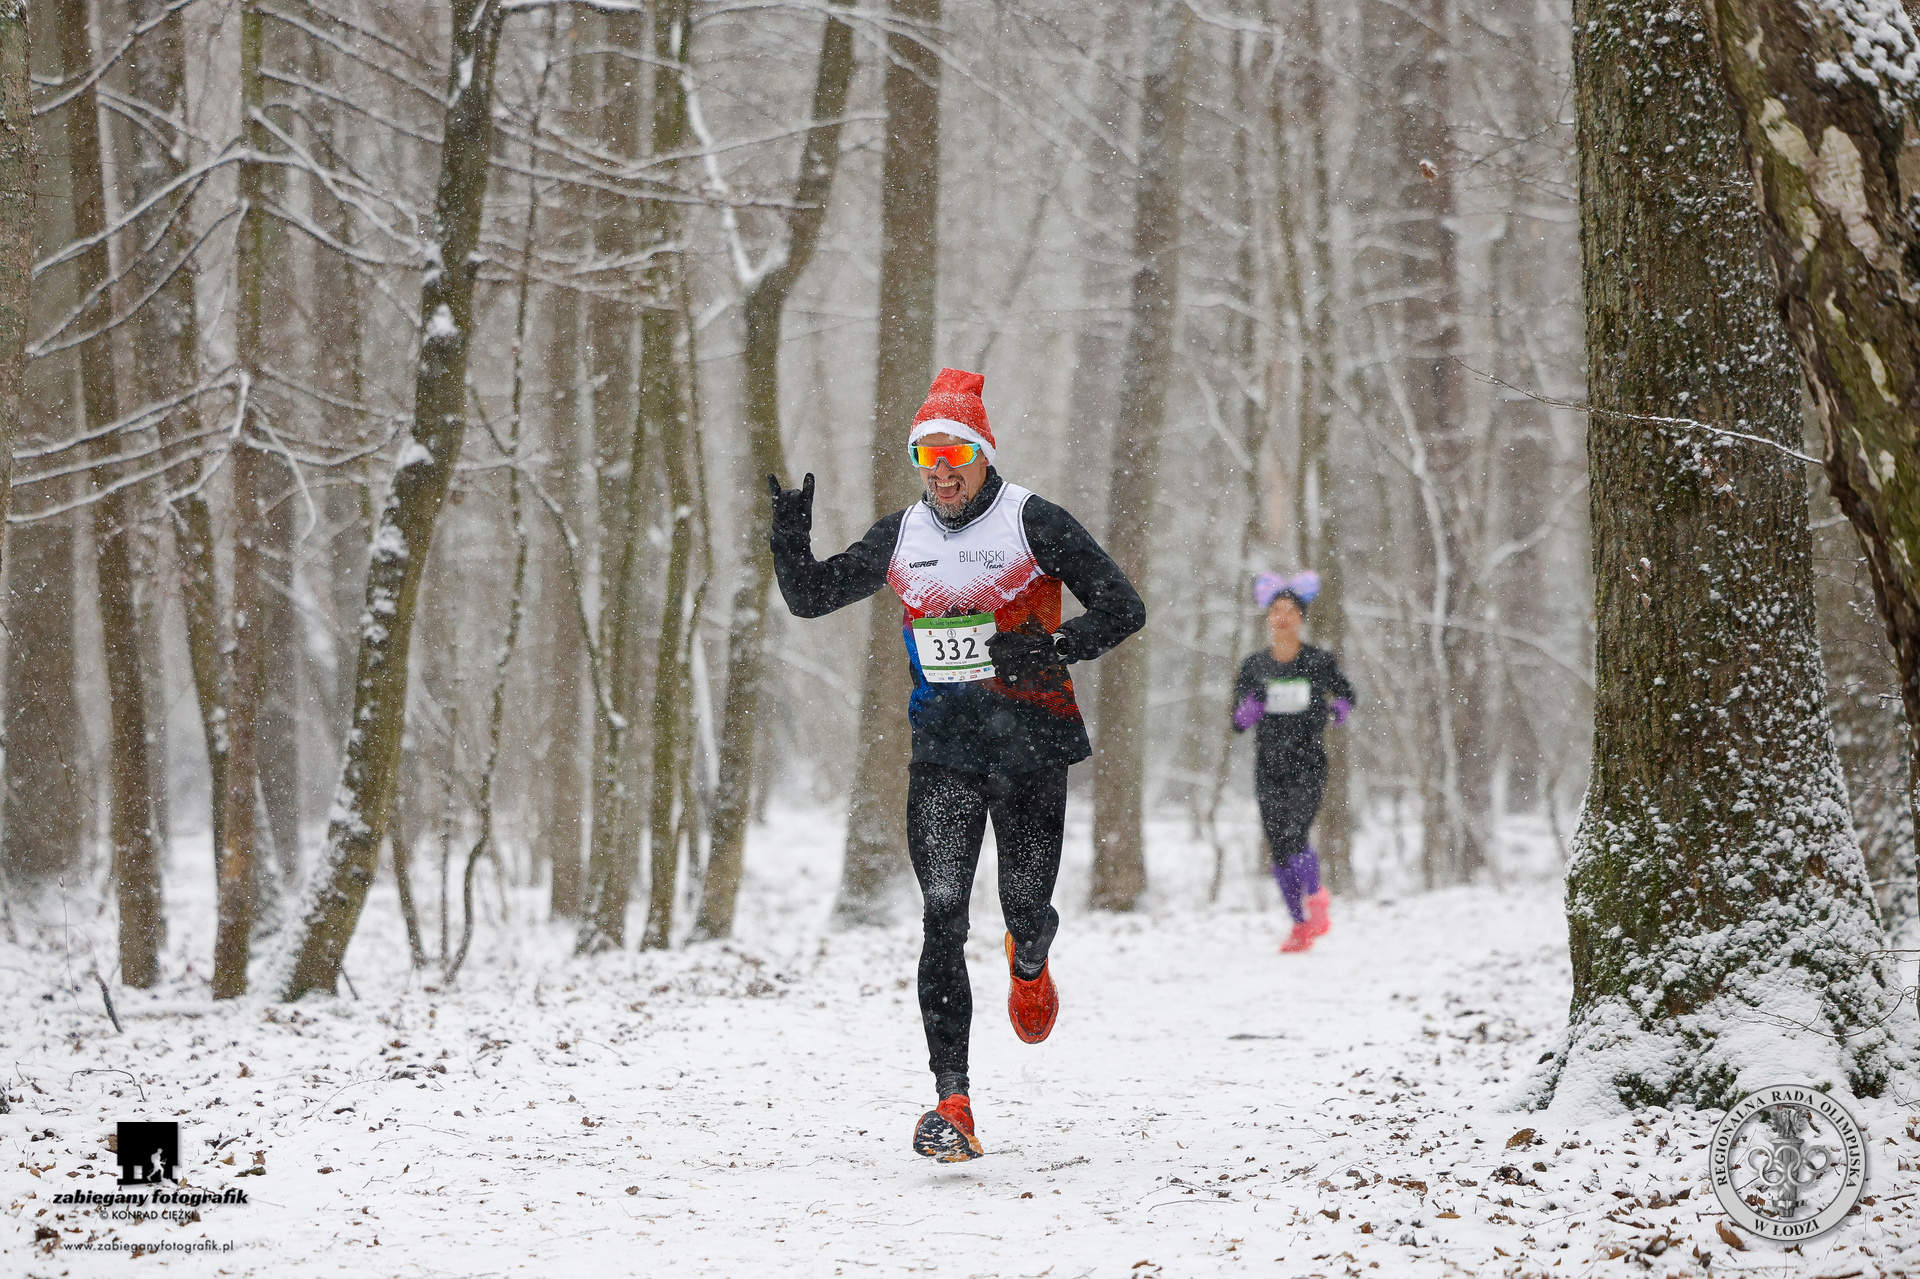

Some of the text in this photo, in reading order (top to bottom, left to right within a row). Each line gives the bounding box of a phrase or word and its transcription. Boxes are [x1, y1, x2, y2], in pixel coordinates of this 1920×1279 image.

[959, 550, 1005, 563] BILIŃSKI
[909, 559, 939, 569] VERGE
[983, 561, 1005, 570] Team
[933, 637, 979, 661] 332
